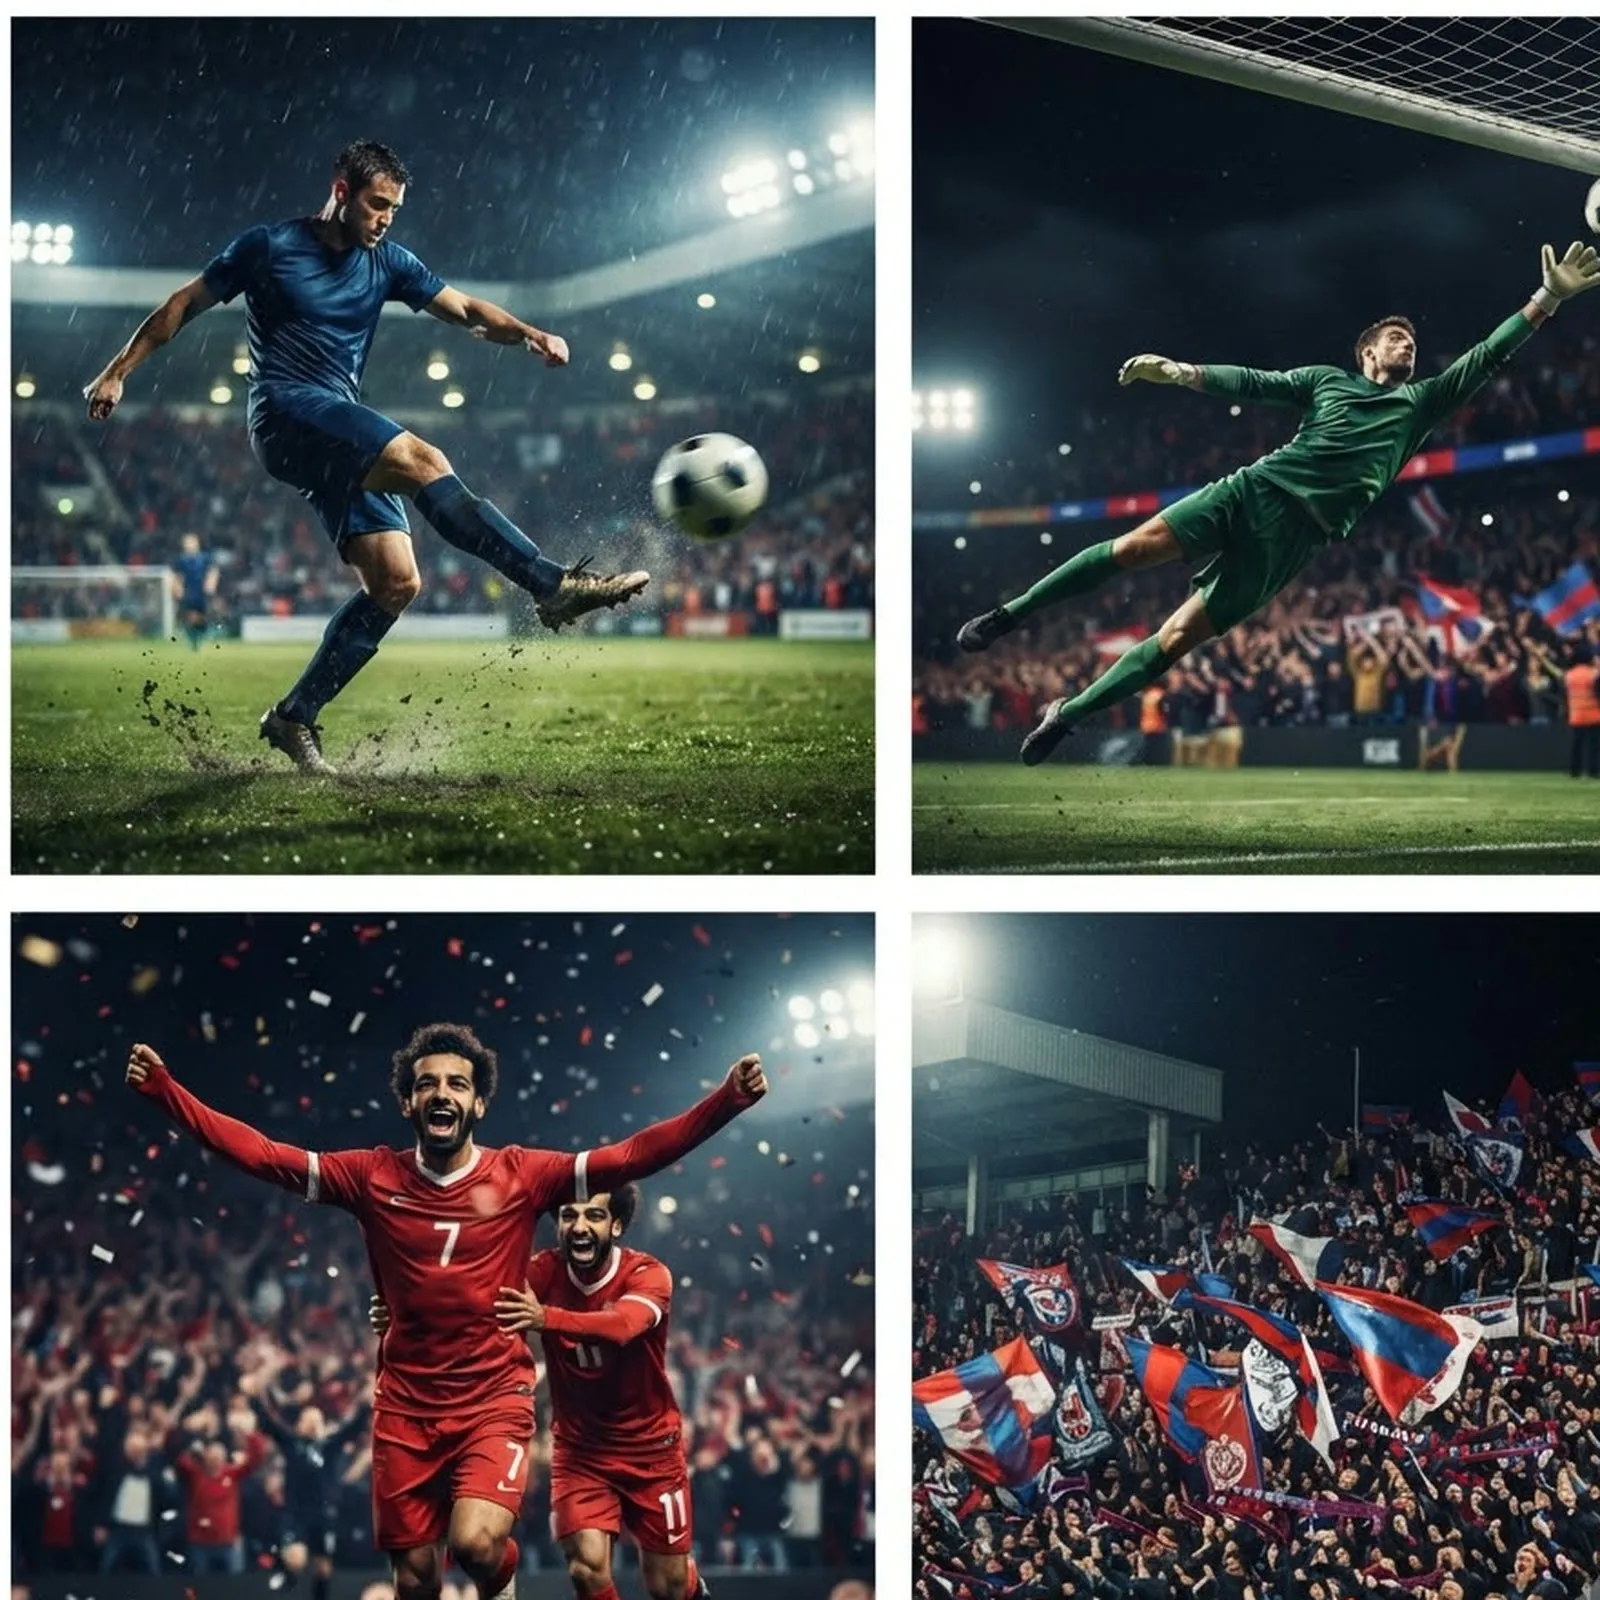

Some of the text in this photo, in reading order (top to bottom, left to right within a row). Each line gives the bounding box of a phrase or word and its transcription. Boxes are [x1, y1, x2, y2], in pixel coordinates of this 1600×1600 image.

[434, 1222, 460, 1267] 7
[575, 1343, 602, 1368] 11
[507, 1442, 524, 1480] 7
[659, 1489, 687, 1530] 11
